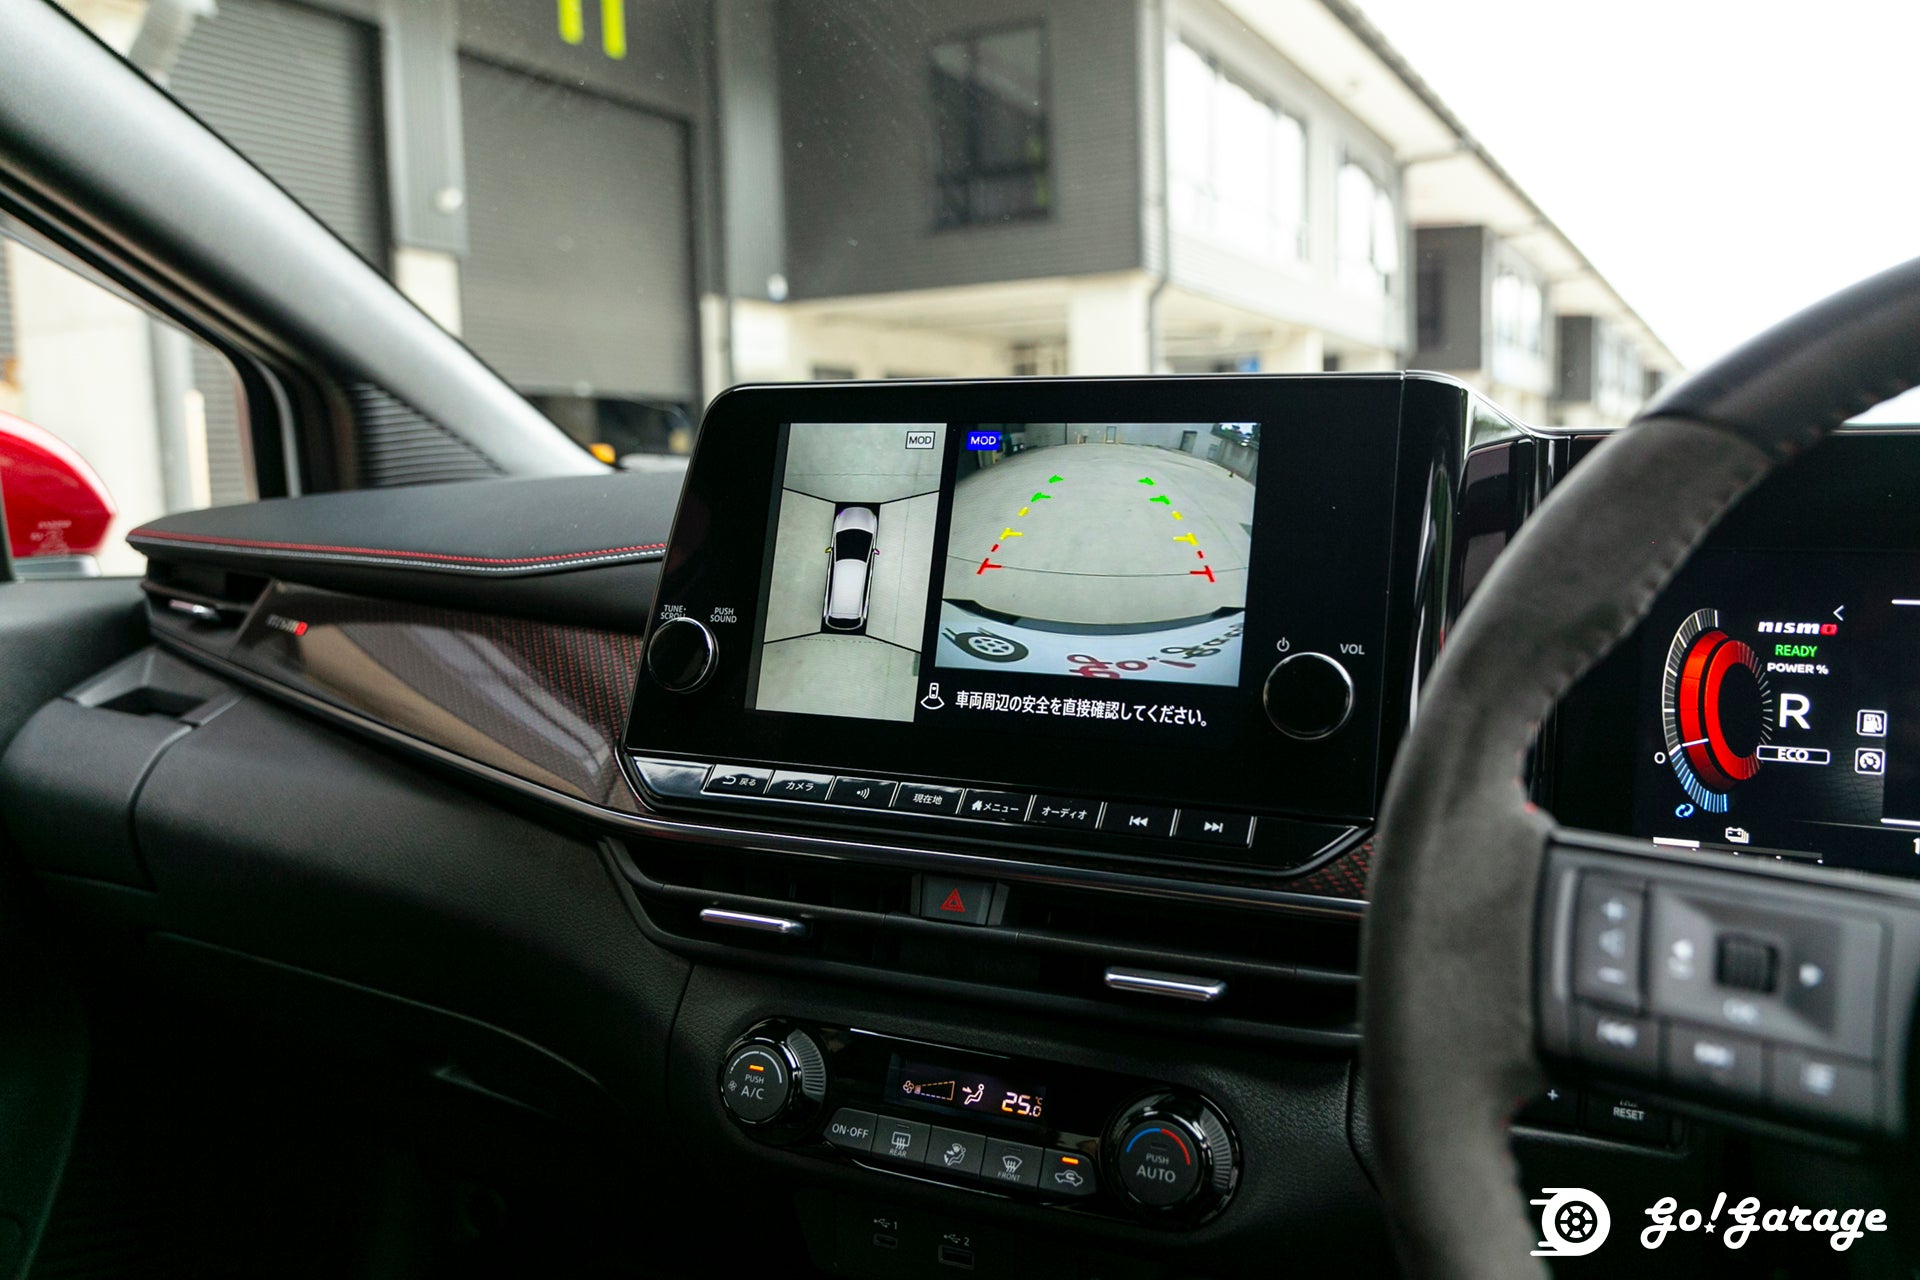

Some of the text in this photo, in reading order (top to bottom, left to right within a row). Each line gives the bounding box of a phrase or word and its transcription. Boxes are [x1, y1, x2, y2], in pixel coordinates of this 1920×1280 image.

[908, 435, 932, 446] MOD
[970, 435, 997, 446] MOD
[714, 606, 735, 616] PUSH
[709, 614, 738, 624] SOUND
[1757, 621, 1839, 636] nismo
[1340, 643, 1366, 655] VOL
[1774, 643, 1818, 658] READY
[1766, 662, 1830, 675] POWER %
[955, 690, 1208, 727] 車両周辺の安全を直接確認してください。
[1778, 692, 1811, 730] R
[1777, 748, 1810, 762] ECO
[738, 777, 757, 787] 戻る
[785, 781, 815, 792] カメラ
[912, 792, 943, 805] 現在地
[982, 801, 1020, 813] メニュー
[1041, 805, 1088, 820] オーディオ
[744, 1073, 765, 1085] PUSH
[740, 1085, 765, 1100] A/C
[1612, 1106, 1646, 1121] RESET
[888, 1149, 908, 1159] REAR
[1145, 1152, 1170, 1165] PUSH
[997, 1171, 1021, 1183] FRONT
[1136, 1164, 1177, 1184] AUTO
[963, 1236, 970, 1247] 2
